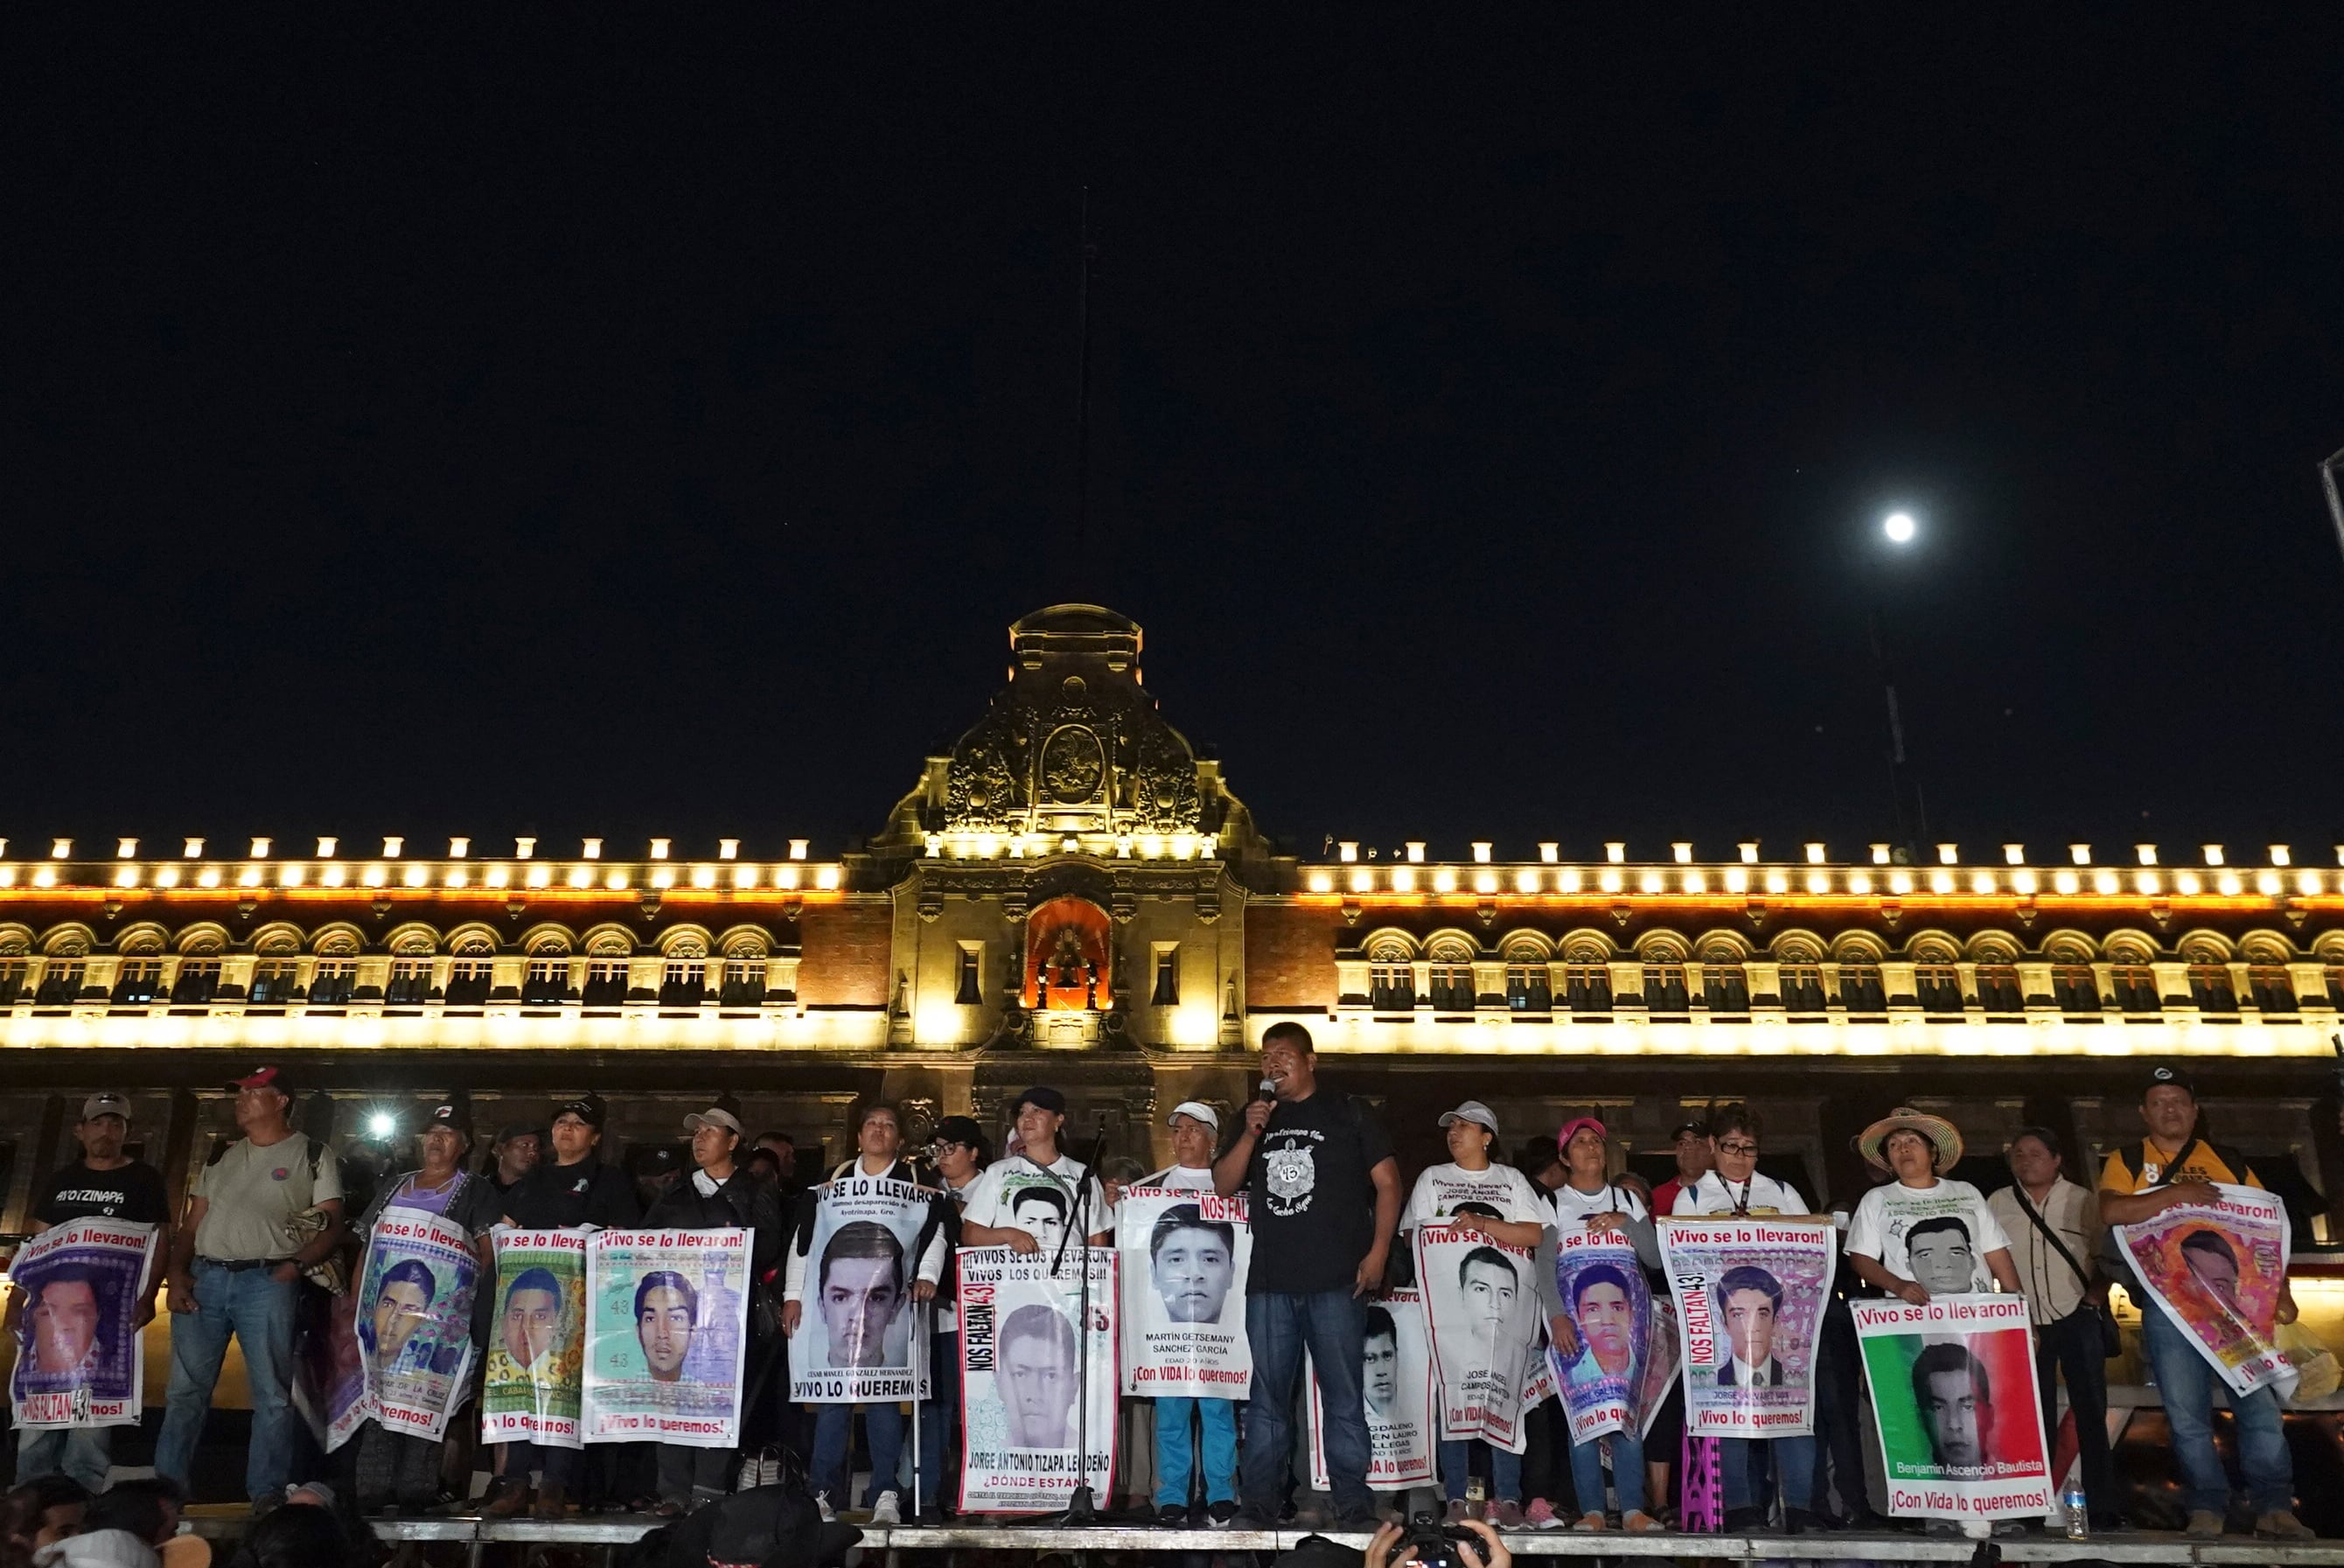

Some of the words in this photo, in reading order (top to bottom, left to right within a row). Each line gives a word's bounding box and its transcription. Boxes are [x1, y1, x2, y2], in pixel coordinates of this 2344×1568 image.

[1282, 1167, 1298, 1181] 43
[56, 1190, 124, 1203] AYOTZINAPA
[833, 1181, 847, 1199] SE
[852, 1180, 869, 1196] LO
[876, 1180, 935, 1203] LLEVARO
[1201, 1196, 1224, 1219] NOS
[1228, 1197, 1249, 1222] FAL
[394, 1223, 409, 1236] se
[413, 1223, 426, 1238] lo
[1670, 1230, 1707, 1246] ¡Vivo
[1713, 1234, 1732, 1243] se
[1737, 1229, 1751, 1242] lo
[1755, 1229, 1824, 1244] llevaron!
[51, 1236, 64, 1251] se
[66, 1231, 79, 1245] lo
[82, 1229, 147, 1250] llevaron!
[513, 1236, 530, 1247] se
[533, 1233, 547, 1247] lo
[551, 1233, 587, 1250] lleva
[599, 1232, 633, 1250] ¡Vivo
[638, 1235, 655, 1246] se
[659, 1234, 673, 1247] lo
[677, 1233, 743, 1248] llevaron!
[1423, 1230, 1459, 1248] ¡Vivo
[1462, 1230, 1479, 1243] se
[1482, 1232, 1494, 1246] lo
[1566, 1236, 1582, 1248] se
[1587, 1232, 1601, 1246] lo
[1009, 1251, 1022, 1264] SE
[1027, 1251, 1047, 1264] LOS
[968, 1269, 1002, 1282] VIVOS
[1009, 1269, 1029, 1280] LOS
[1676, 1272, 1707, 1292] 43!
[963, 1283, 995, 1304] 43!
[610, 1300, 630, 1315] 43
[1684, 1291, 1713, 1335] FALTAN
[1857, 1308, 1900, 1330] ¡Vivo
[1904, 1307, 1924, 1321] se
[1928, 1304, 1943, 1321] lo
[1949, 1301, 2026, 1321] llevaron!
[966, 1304, 994, 1345] FALTAN
[1146, 1332, 1181, 1342] MARTÍN
[1182, 1333, 1235, 1344] GETSEMANY
[1153, 1343, 1194, 1354] SÁNCHEZ
[1196, 1346, 1228, 1355] GARCÍA
[1692, 1338, 1714, 1364] NOS
[610, 1353, 629, 1368] 43
[966, 1348, 994, 1371] NOS
[1200, 1357, 1219, 1366] AÑOS
[1134, 1366, 1156, 1385] ¡Con
[1160, 1366, 1182, 1381] VIDA
[1184, 1367, 1195, 1381] lo
[1199, 1369, 1247, 1384] queremos!
[793, 1381, 822, 1398] VIVO
[827, 1381, 843, 1397] LO
[1536, 1378, 1548, 1390] lo
[91, 1402, 122, 1416] mos!
[1449, 1407, 1463, 1425] ¡Con
[1595, 1409, 1607, 1423] lo
[503, 1414, 516, 1428] lo
[644, 1414, 656, 1428] lo
[1369, 1422, 1413, 1432] GDALENO
[1699, 1410, 1728, 1427] ¡Vivo
[1733, 1411, 1747, 1425] lo
[1752, 1410, 1803, 1429] queremos!
[1371, 1432, 1390, 1441] ÉN
[1392, 1431, 1418, 1439] LAURO
[1372, 1439, 1410, 1449] LLEGAS
[969, 1452, 995, 1470] JORGE
[997, 1450, 1033, 1472] ANTONIO
[1036, 1454, 1064, 1473] TIZAPA
[1068, 1451, 1110, 1472] LEDEÑO
[1385, 1460, 1395, 1474] lo
[1896, 1461, 1944, 1476] Benjamin
[1946, 1463, 1995, 1476] Ascencio
[1997, 1460, 2043, 1474] Bautista
[984, 1475, 1036, 1488] ¿DÓNDE
[1891, 1490, 1921, 1514] ¡Con
[1925, 1491, 1953, 1510] Vida
[1957, 1494, 1968, 1511] lo
[1973, 1488, 2048, 1515] queremos!
